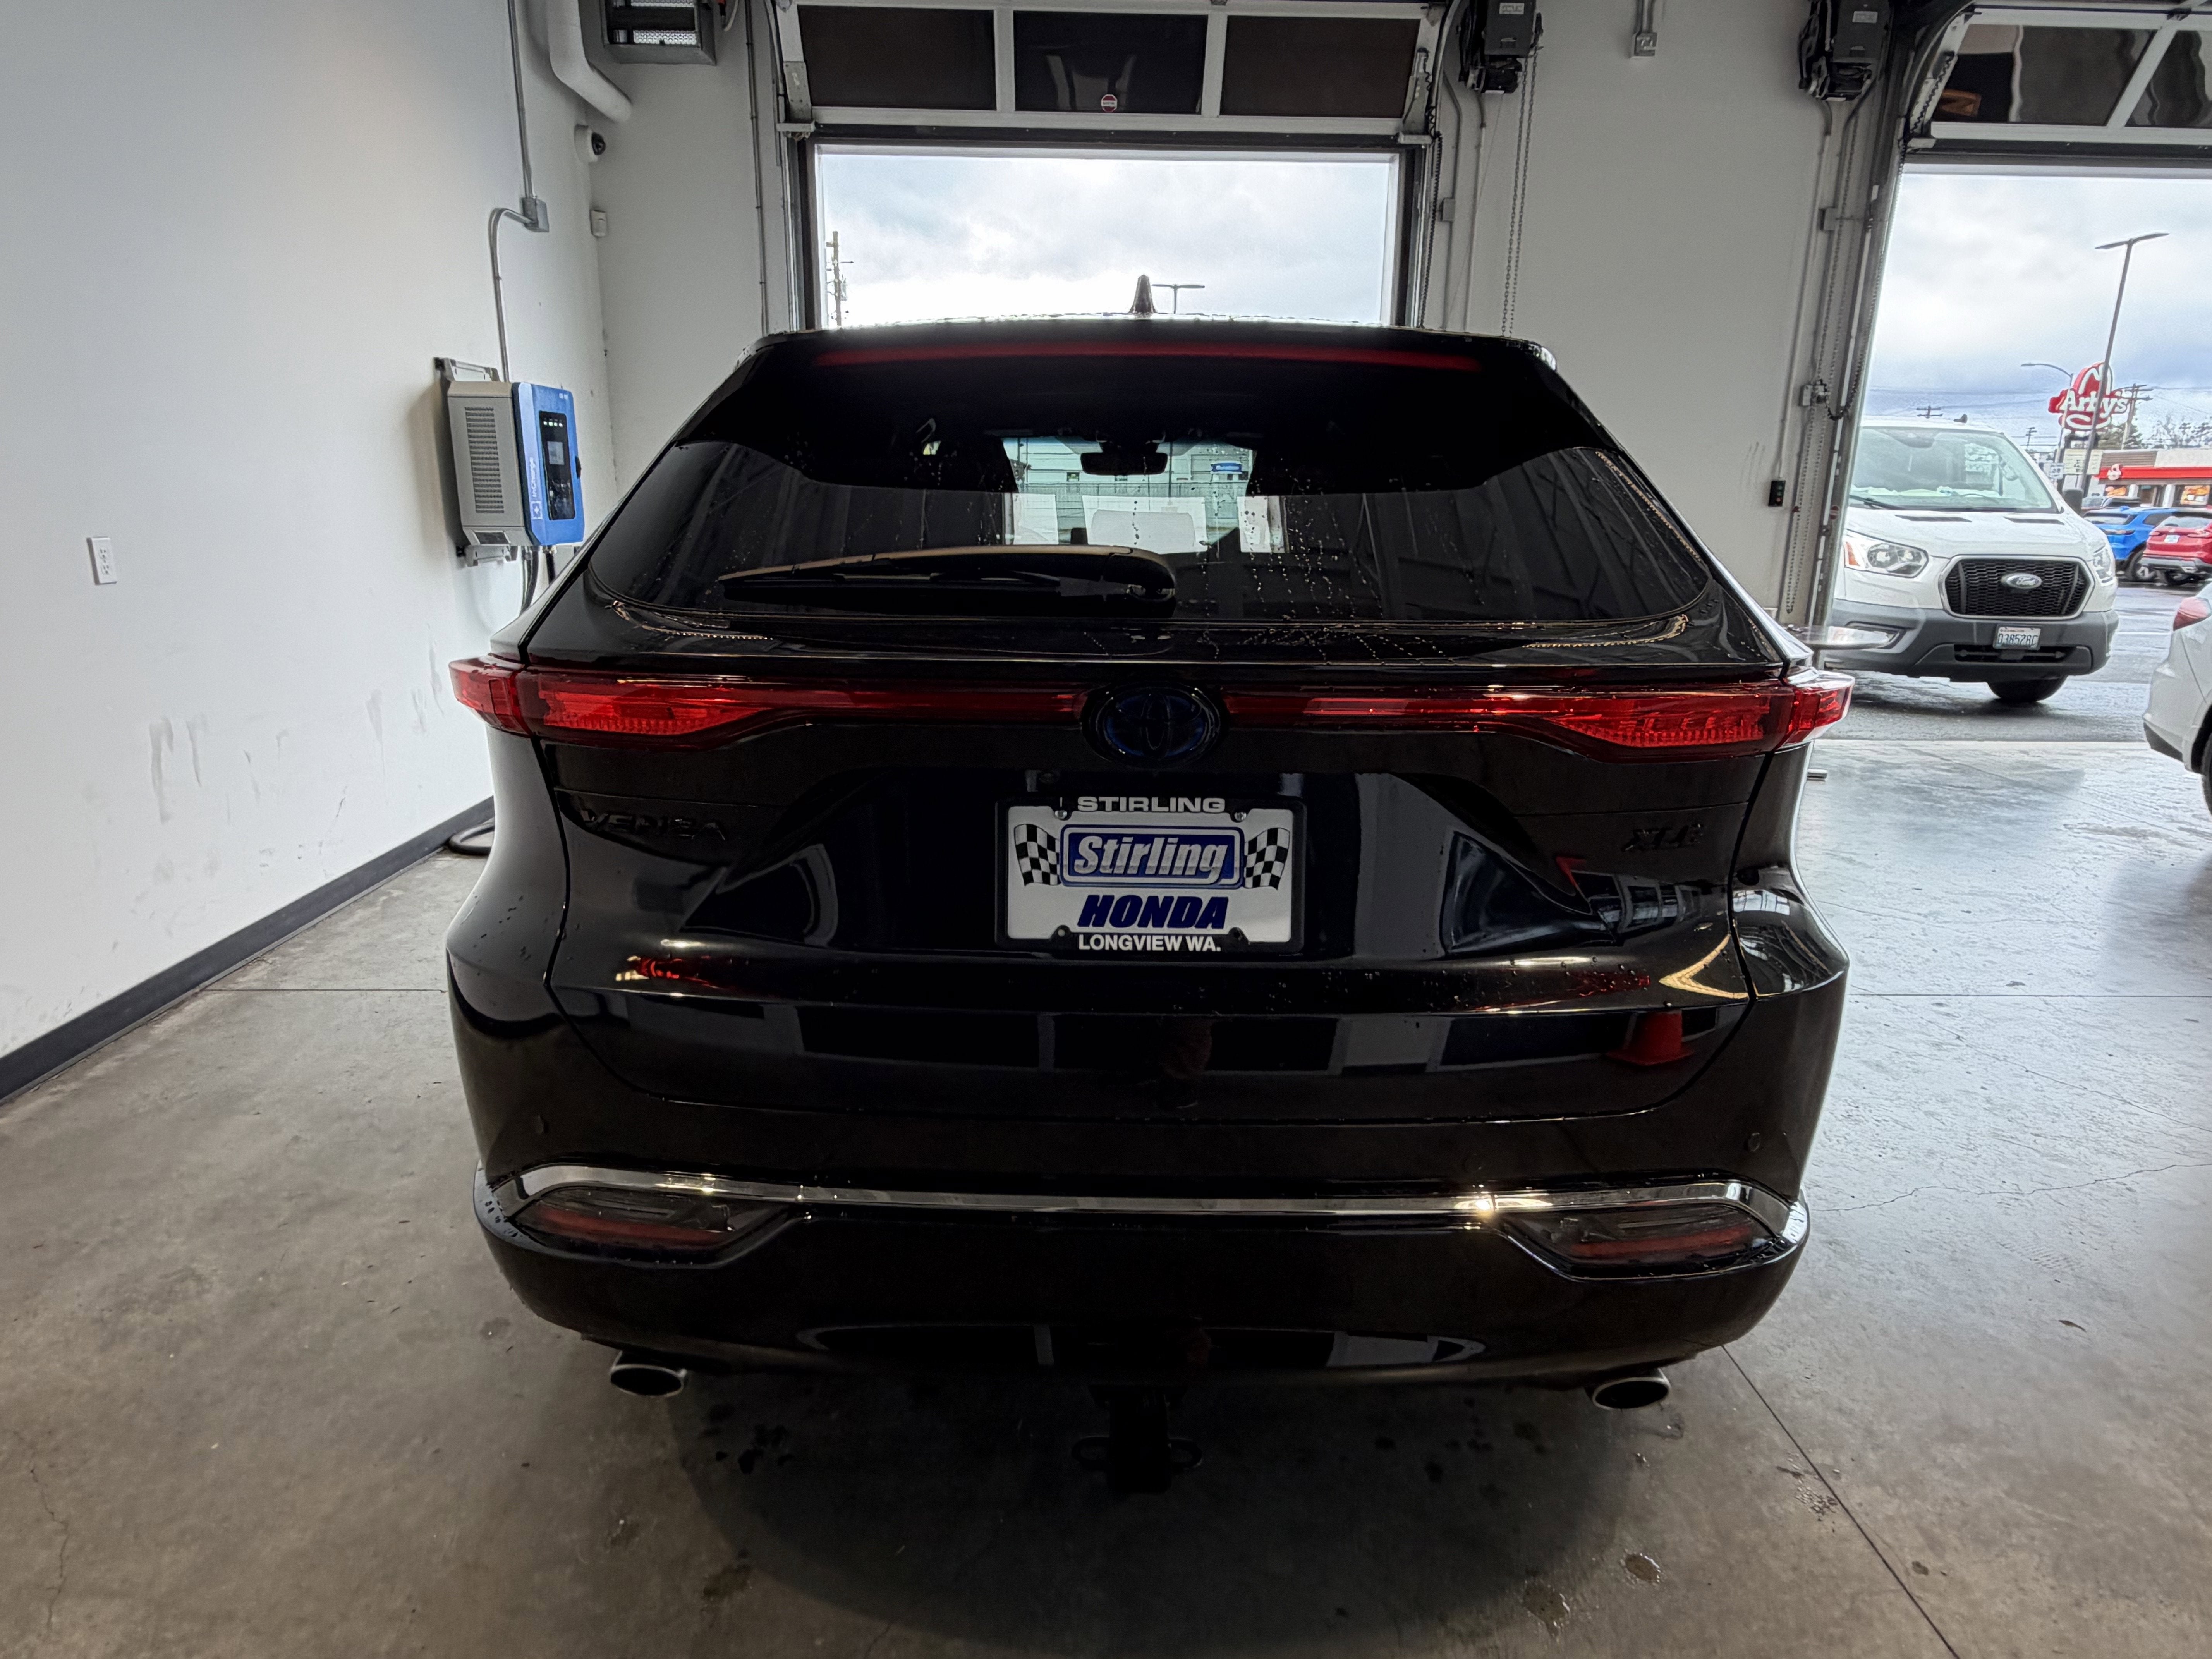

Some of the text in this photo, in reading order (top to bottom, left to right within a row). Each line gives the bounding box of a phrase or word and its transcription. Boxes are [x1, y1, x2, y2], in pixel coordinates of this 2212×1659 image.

[2016, 576, 2036, 586] Ford
[1077, 797, 1225, 812] STIRLING
[1074, 836, 1228, 884] Stirling
[1077, 895, 1228, 929] HONDA
[1079, 935, 1221, 951] LONGVIEW WA.
